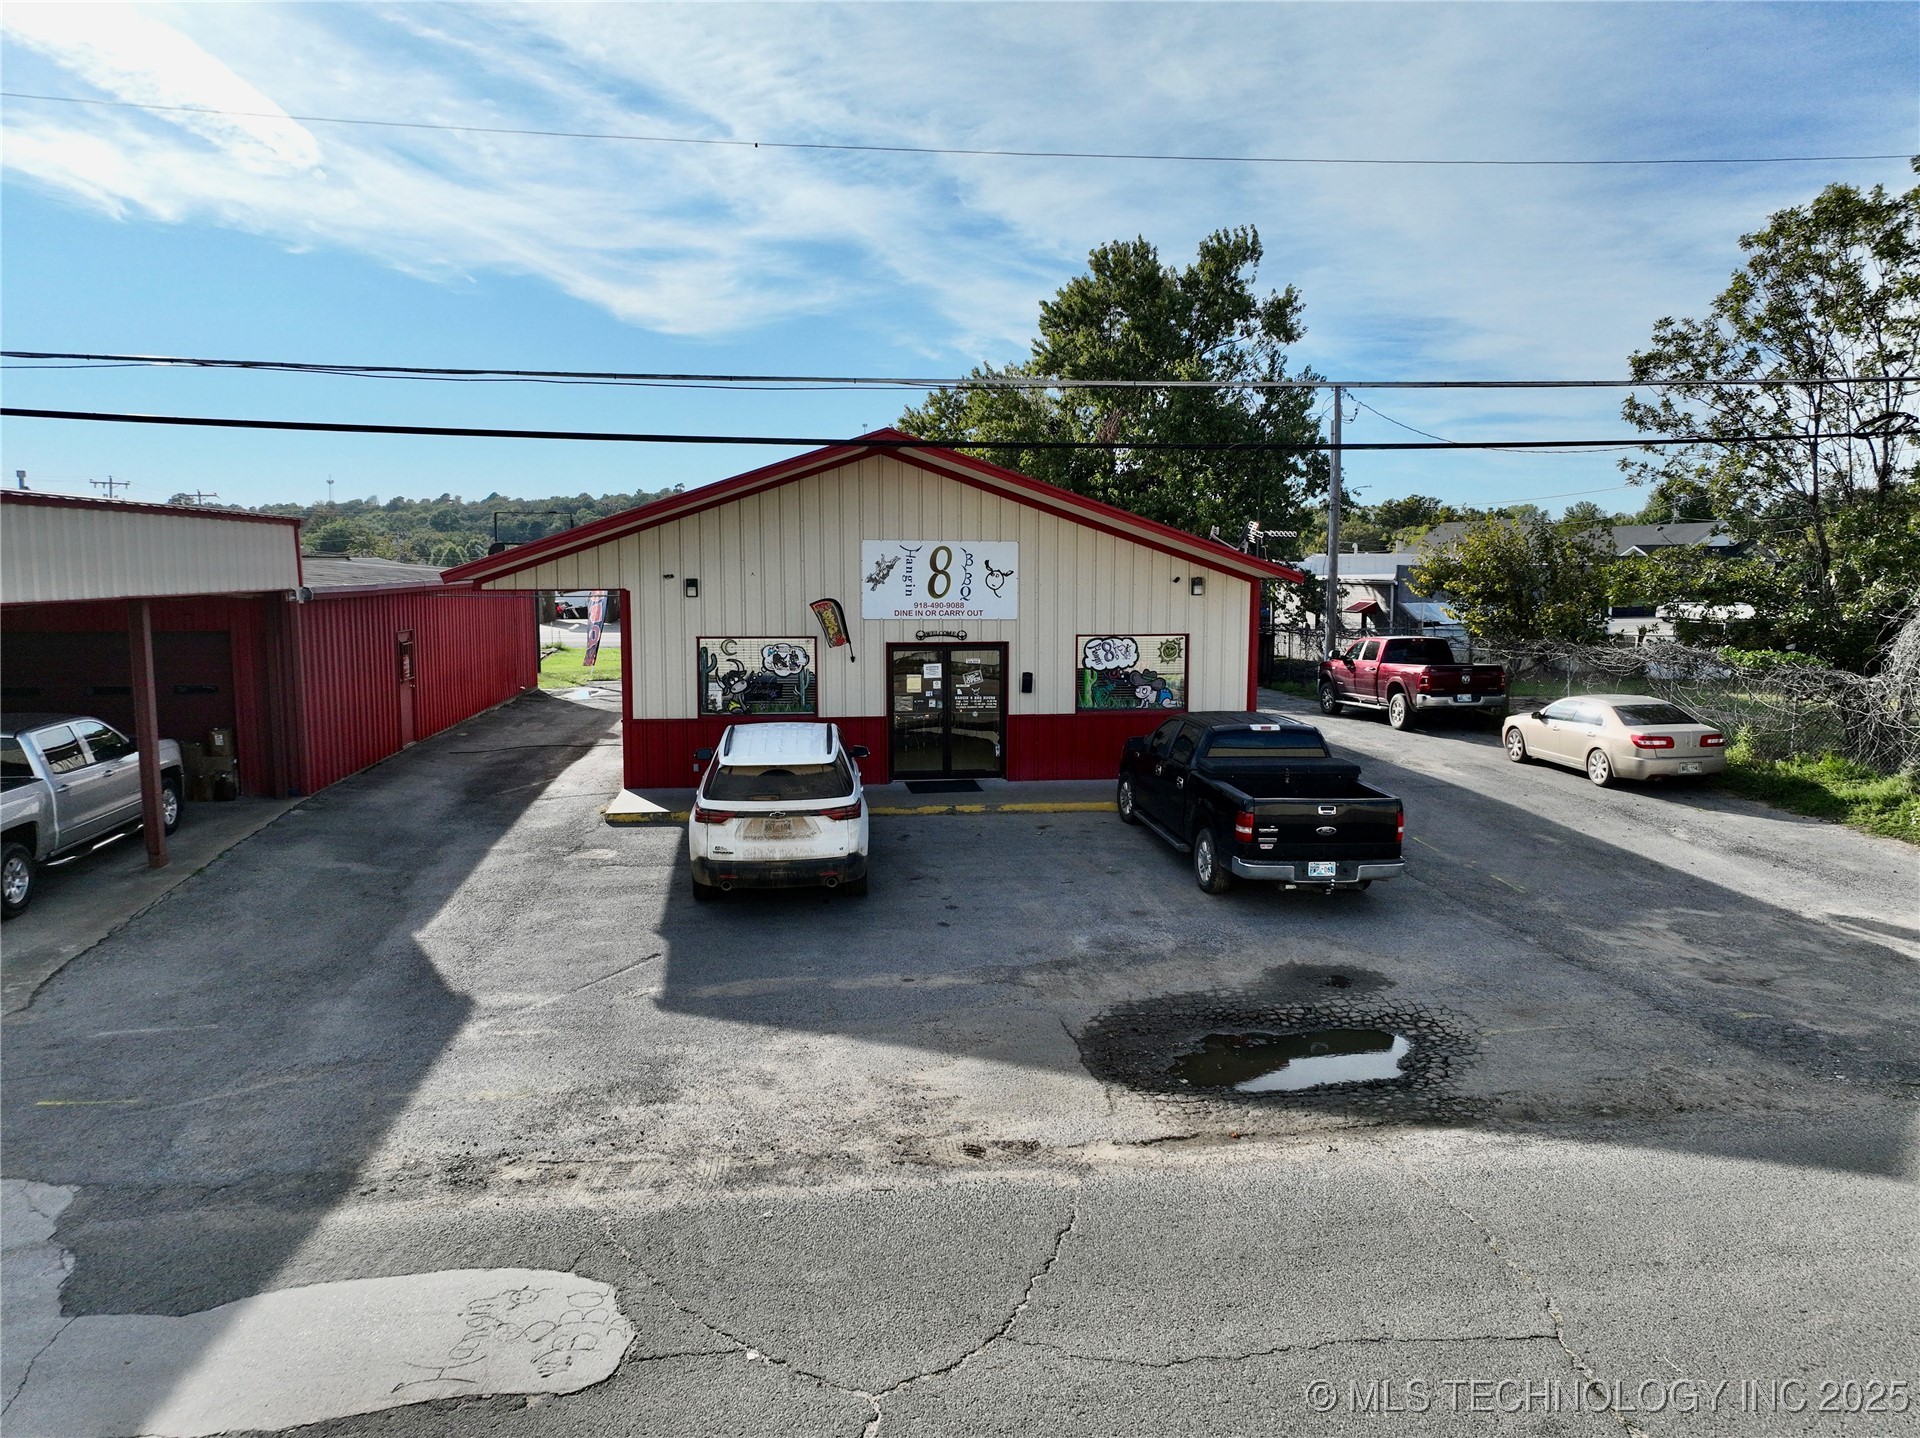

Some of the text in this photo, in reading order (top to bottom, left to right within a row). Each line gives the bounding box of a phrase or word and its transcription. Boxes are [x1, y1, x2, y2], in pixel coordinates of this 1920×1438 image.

[900, 545, 974, 601] Hangin 8 BBQ
[1102, 641, 1114, 662] 8
